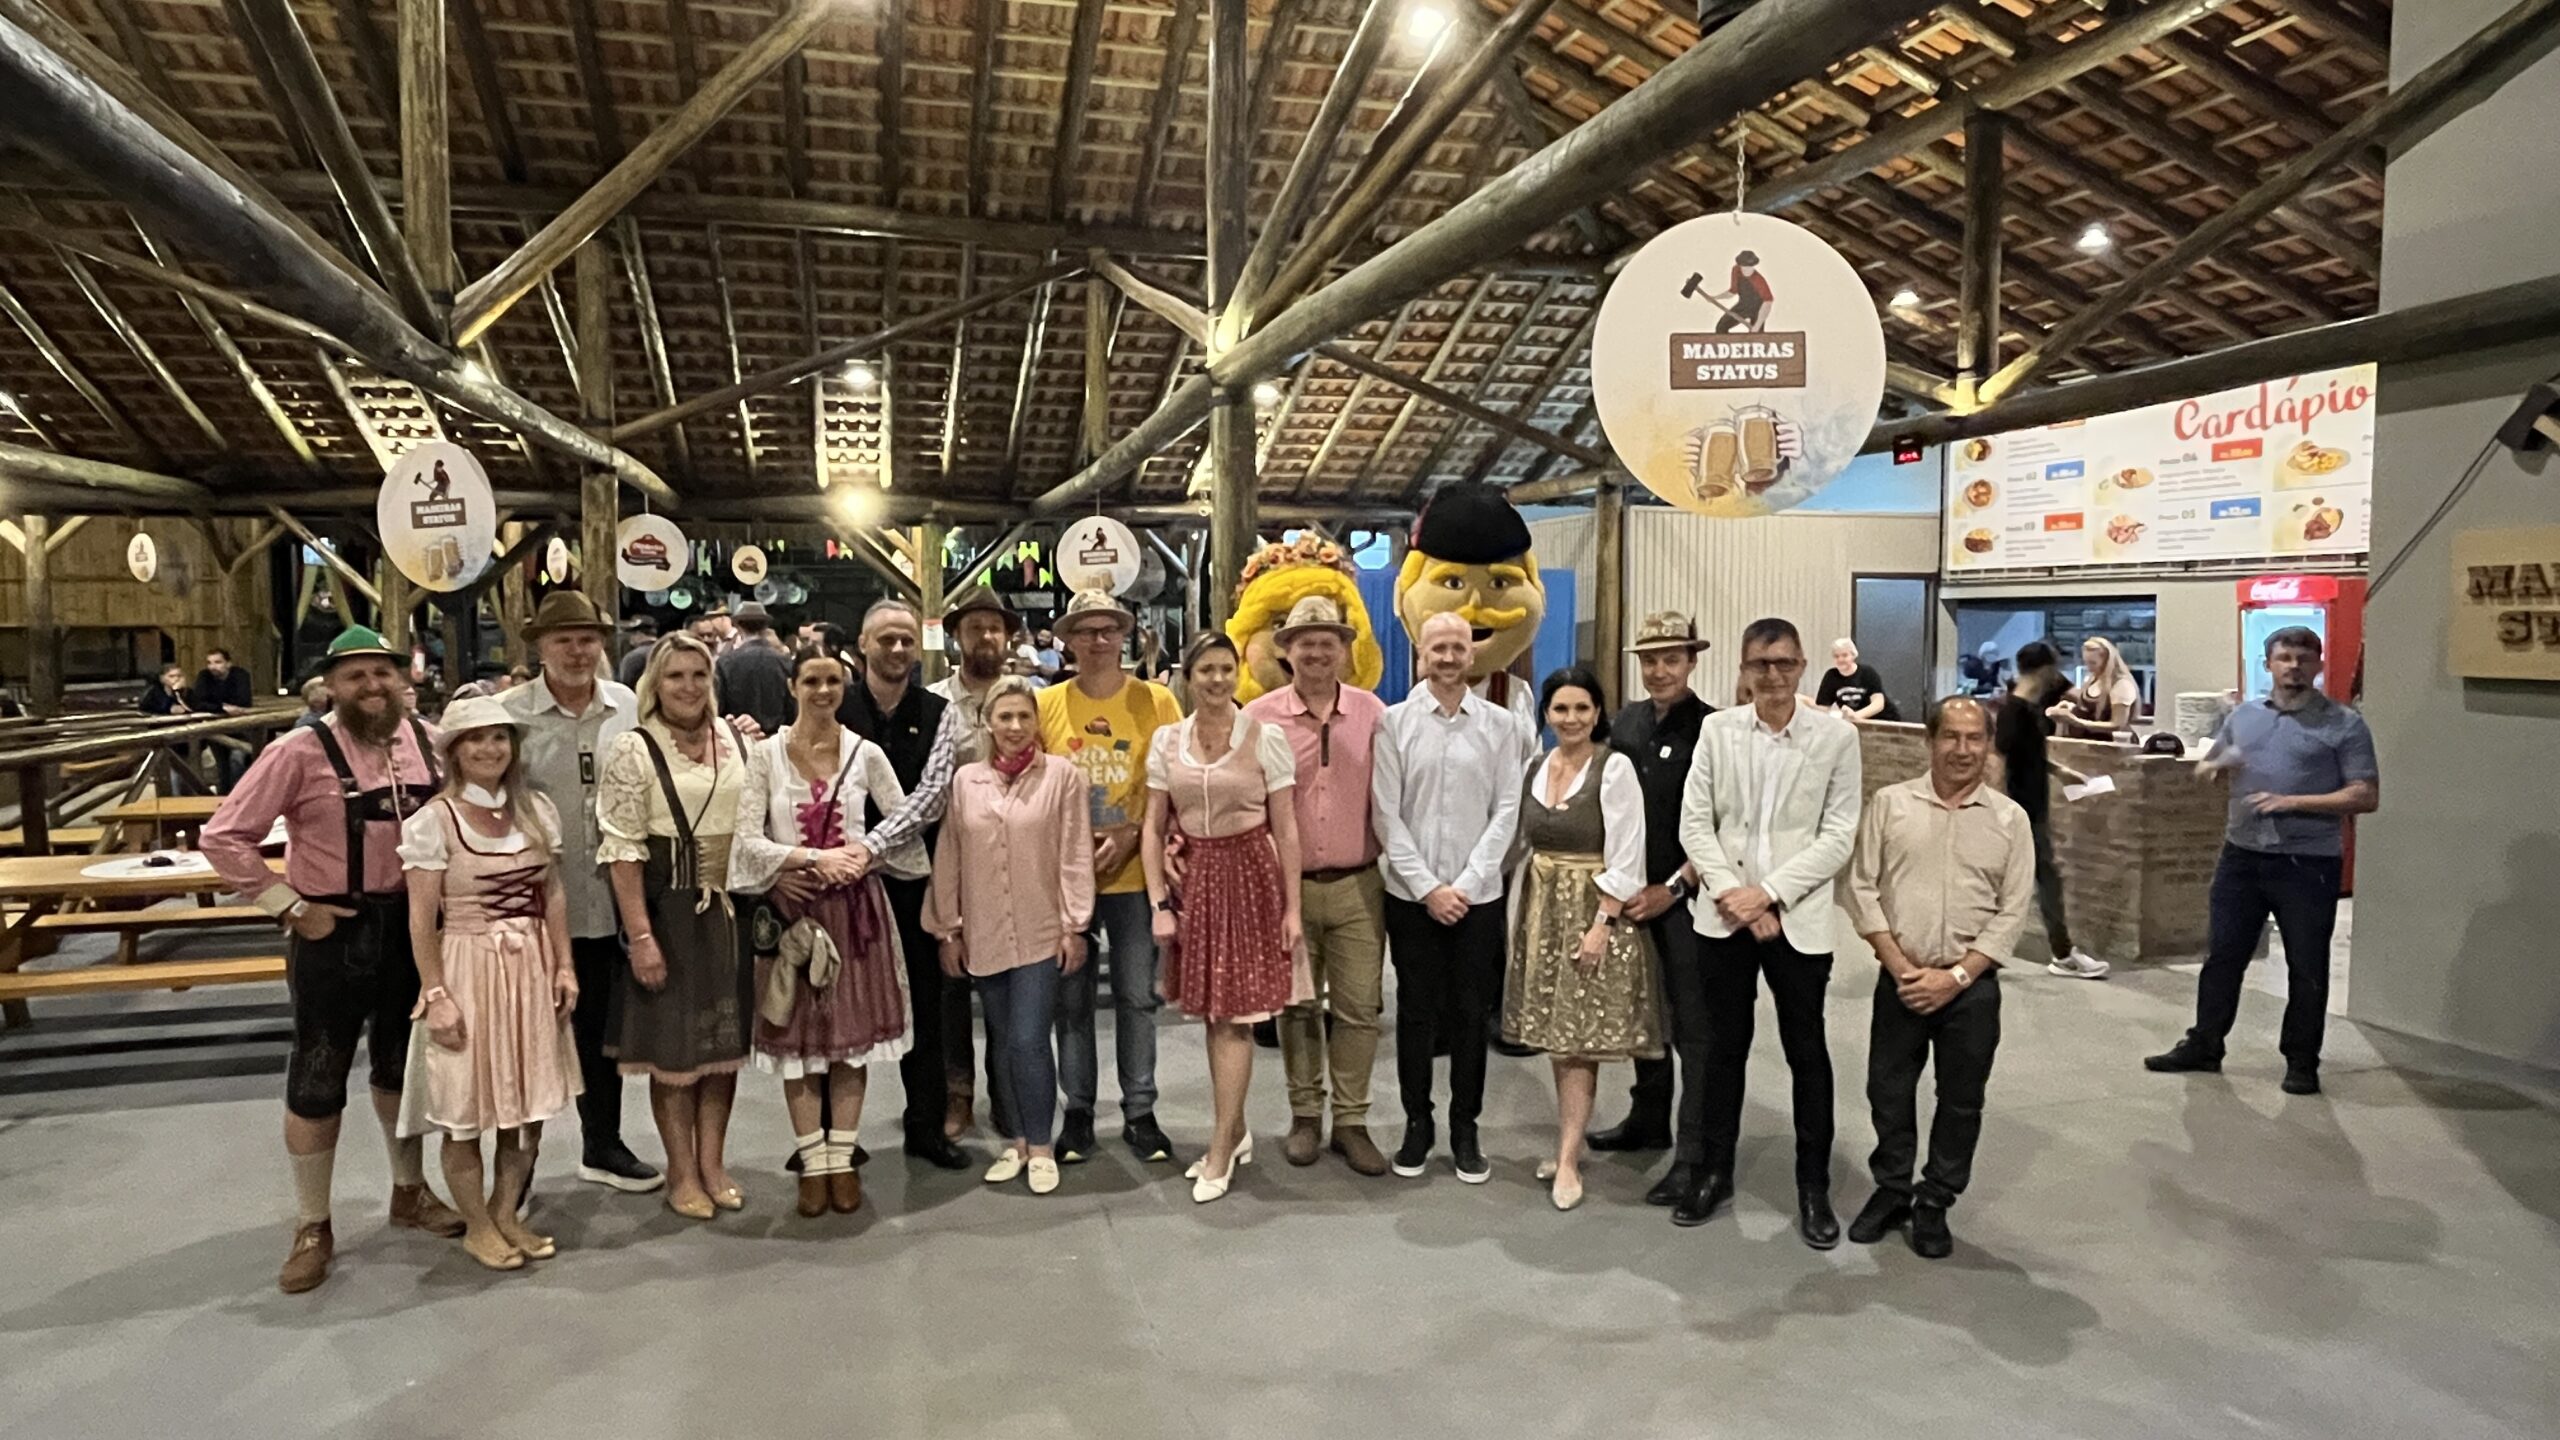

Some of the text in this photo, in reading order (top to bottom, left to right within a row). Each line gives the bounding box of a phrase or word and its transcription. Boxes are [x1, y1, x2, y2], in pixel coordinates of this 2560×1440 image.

[1682, 342, 1795, 360] MADEIRAS
[1696, 363, 1779, 381] STATUS
[2174, 375, 2376, 441] Cardápio
